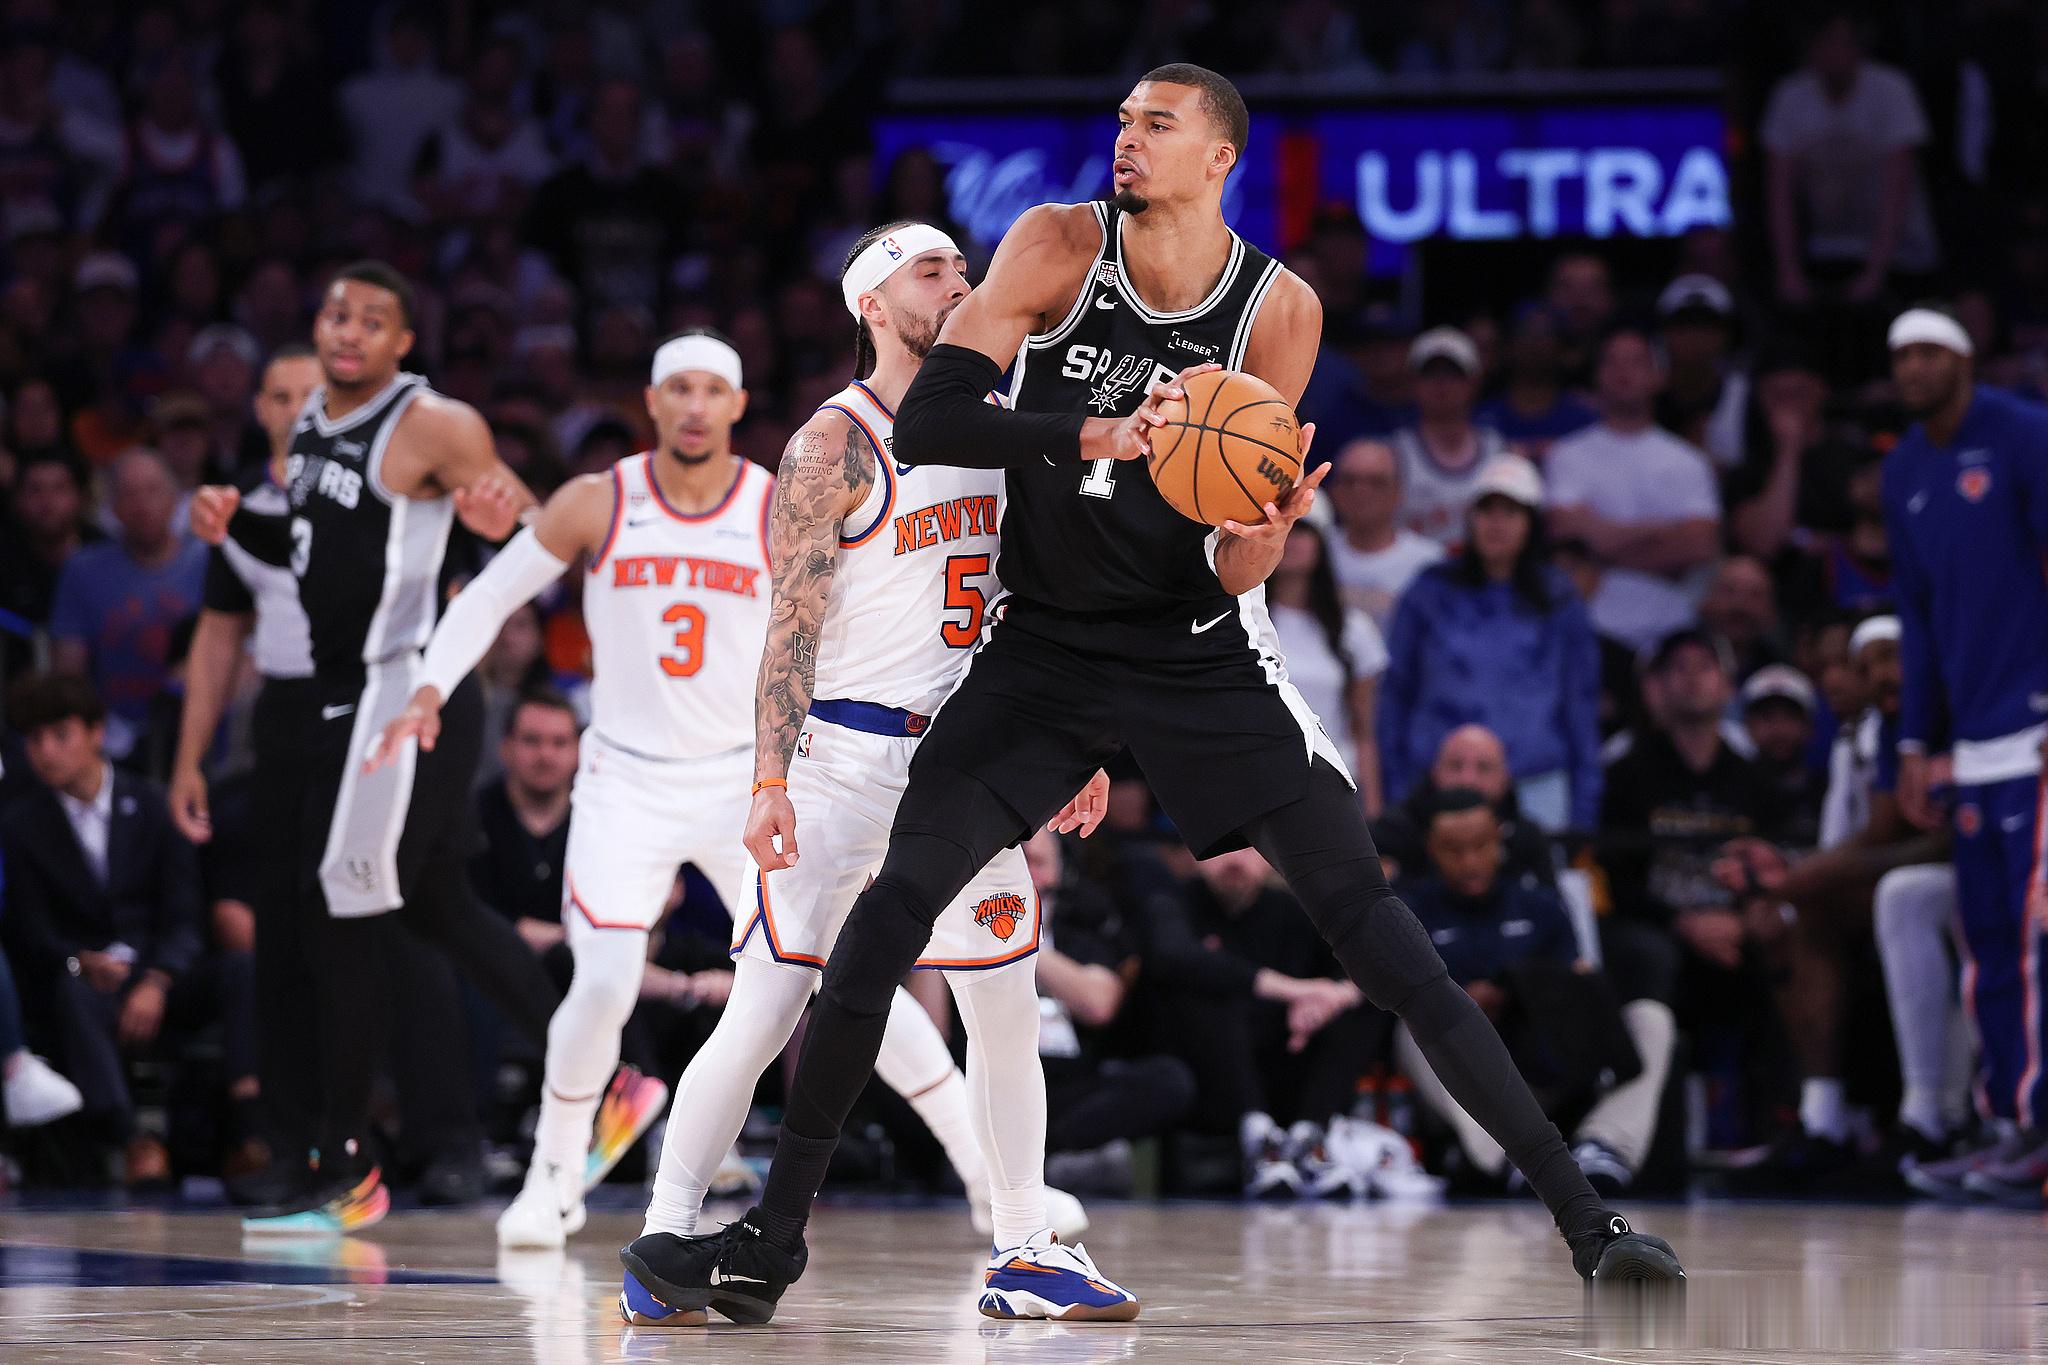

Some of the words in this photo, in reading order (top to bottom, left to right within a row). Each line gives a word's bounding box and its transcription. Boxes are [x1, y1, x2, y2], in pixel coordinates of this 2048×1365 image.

[1355, 146, 1731, 244] ULTRA
[1062, 344, 1179, 412] SPUR
[1175, 337, 1213, 358] LEDGER
[1079, 457, 1116, 500] 1
[289, 516, 313, 578] 3
[894, 498, 962, 558] NEW
[962, 494, 998, 537] YO
[613, 556, 680, 589] NEW
[684, 557, 761, 599] YORK
[940, 553, 990, 649] 5
[659, 602, 706, 678] 3
[974, 894, 1026, 923] KNICKS
